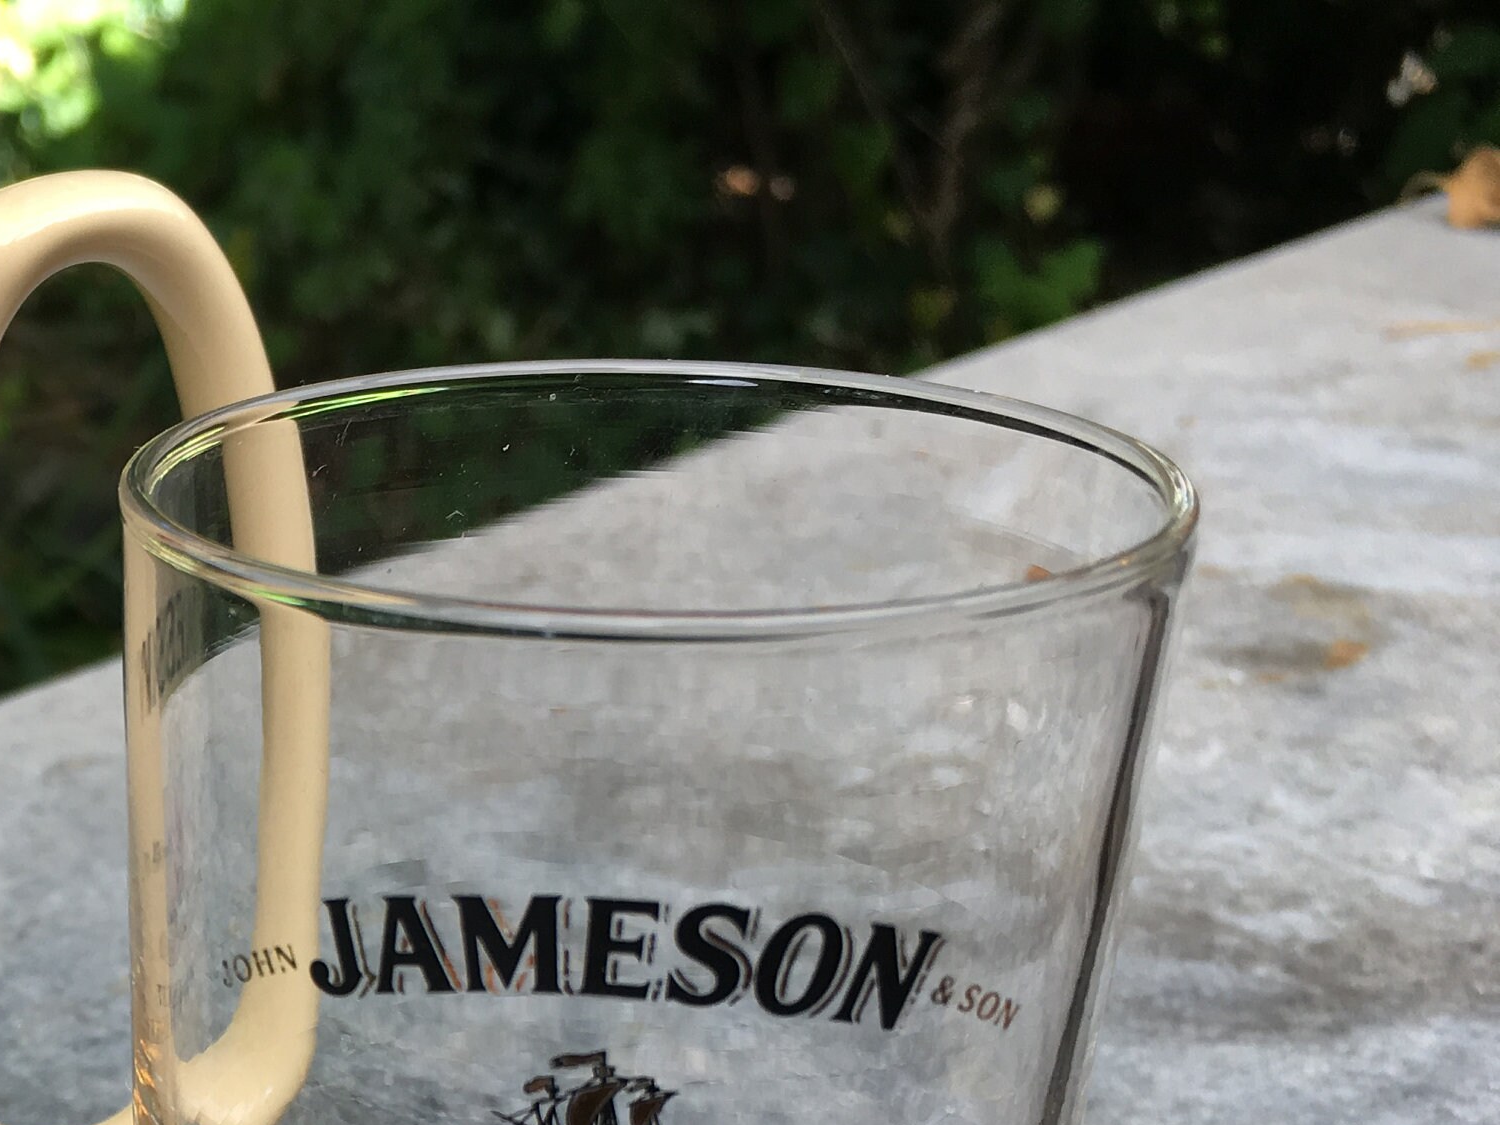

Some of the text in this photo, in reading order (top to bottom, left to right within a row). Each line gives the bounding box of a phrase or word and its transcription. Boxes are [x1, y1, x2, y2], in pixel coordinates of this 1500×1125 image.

[221, 895, 1021, 1032] JOHN JAMESON & SON
